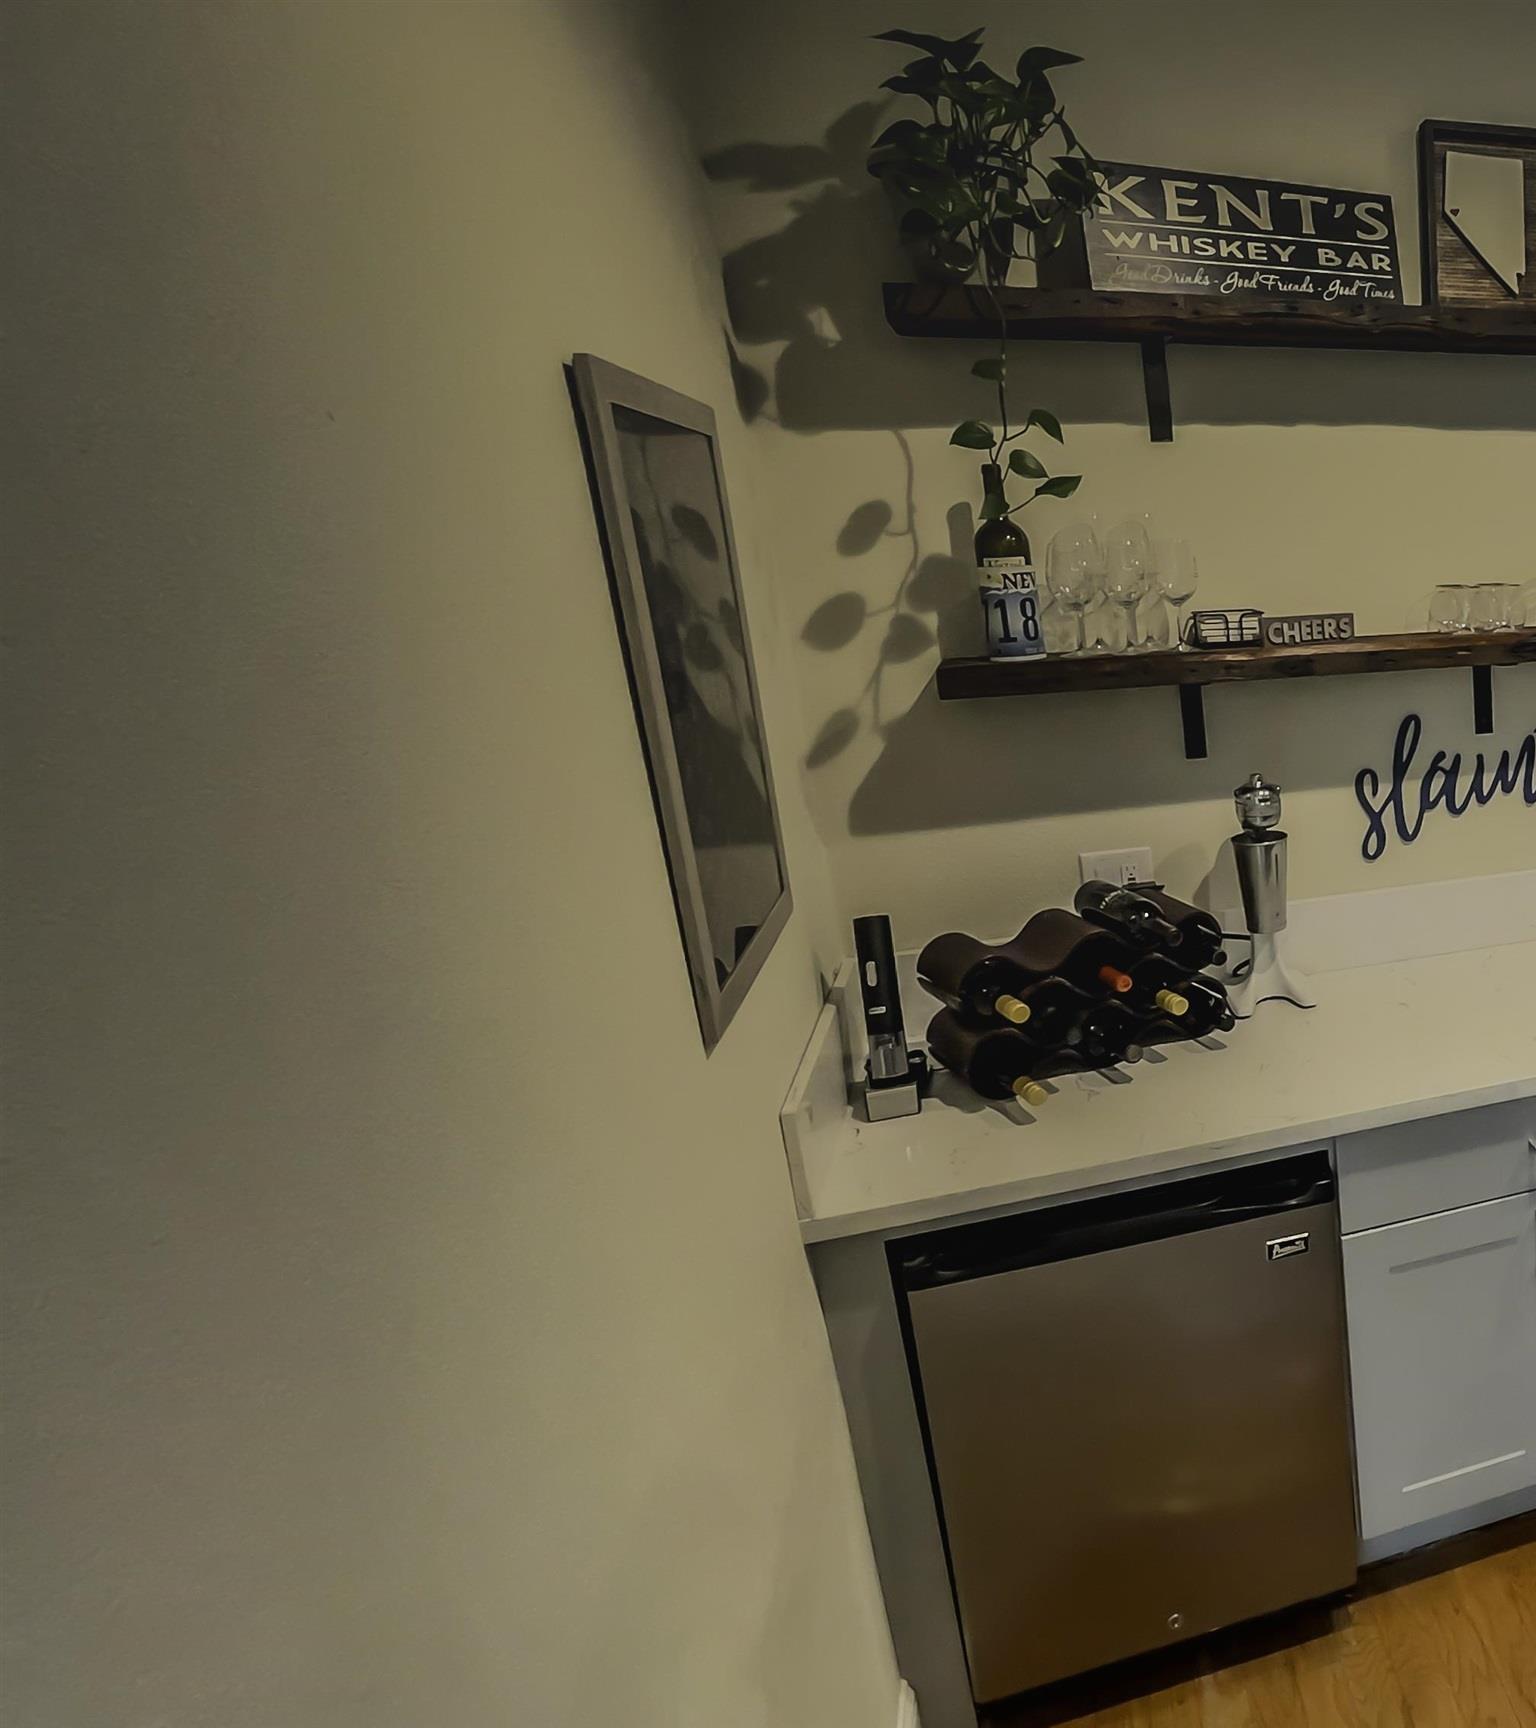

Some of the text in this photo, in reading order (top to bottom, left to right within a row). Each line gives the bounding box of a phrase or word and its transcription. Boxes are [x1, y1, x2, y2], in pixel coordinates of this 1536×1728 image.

[1092, 171, 1390, 241] KENT'S
[1102, 229, 1391, 272] WHISKEY BAR
[1110, 262, 1150, 283] Good
[1151, 264, 1210, 285] Drinks
[1220, 271, 1258, 294] Good
[1259, 274, 1314, 293] Friends
[1323, 278, 1358, 301] Good
[1358, 281, 1395, 299] Times
[1267, 617, 1351, 645] CHEERS
